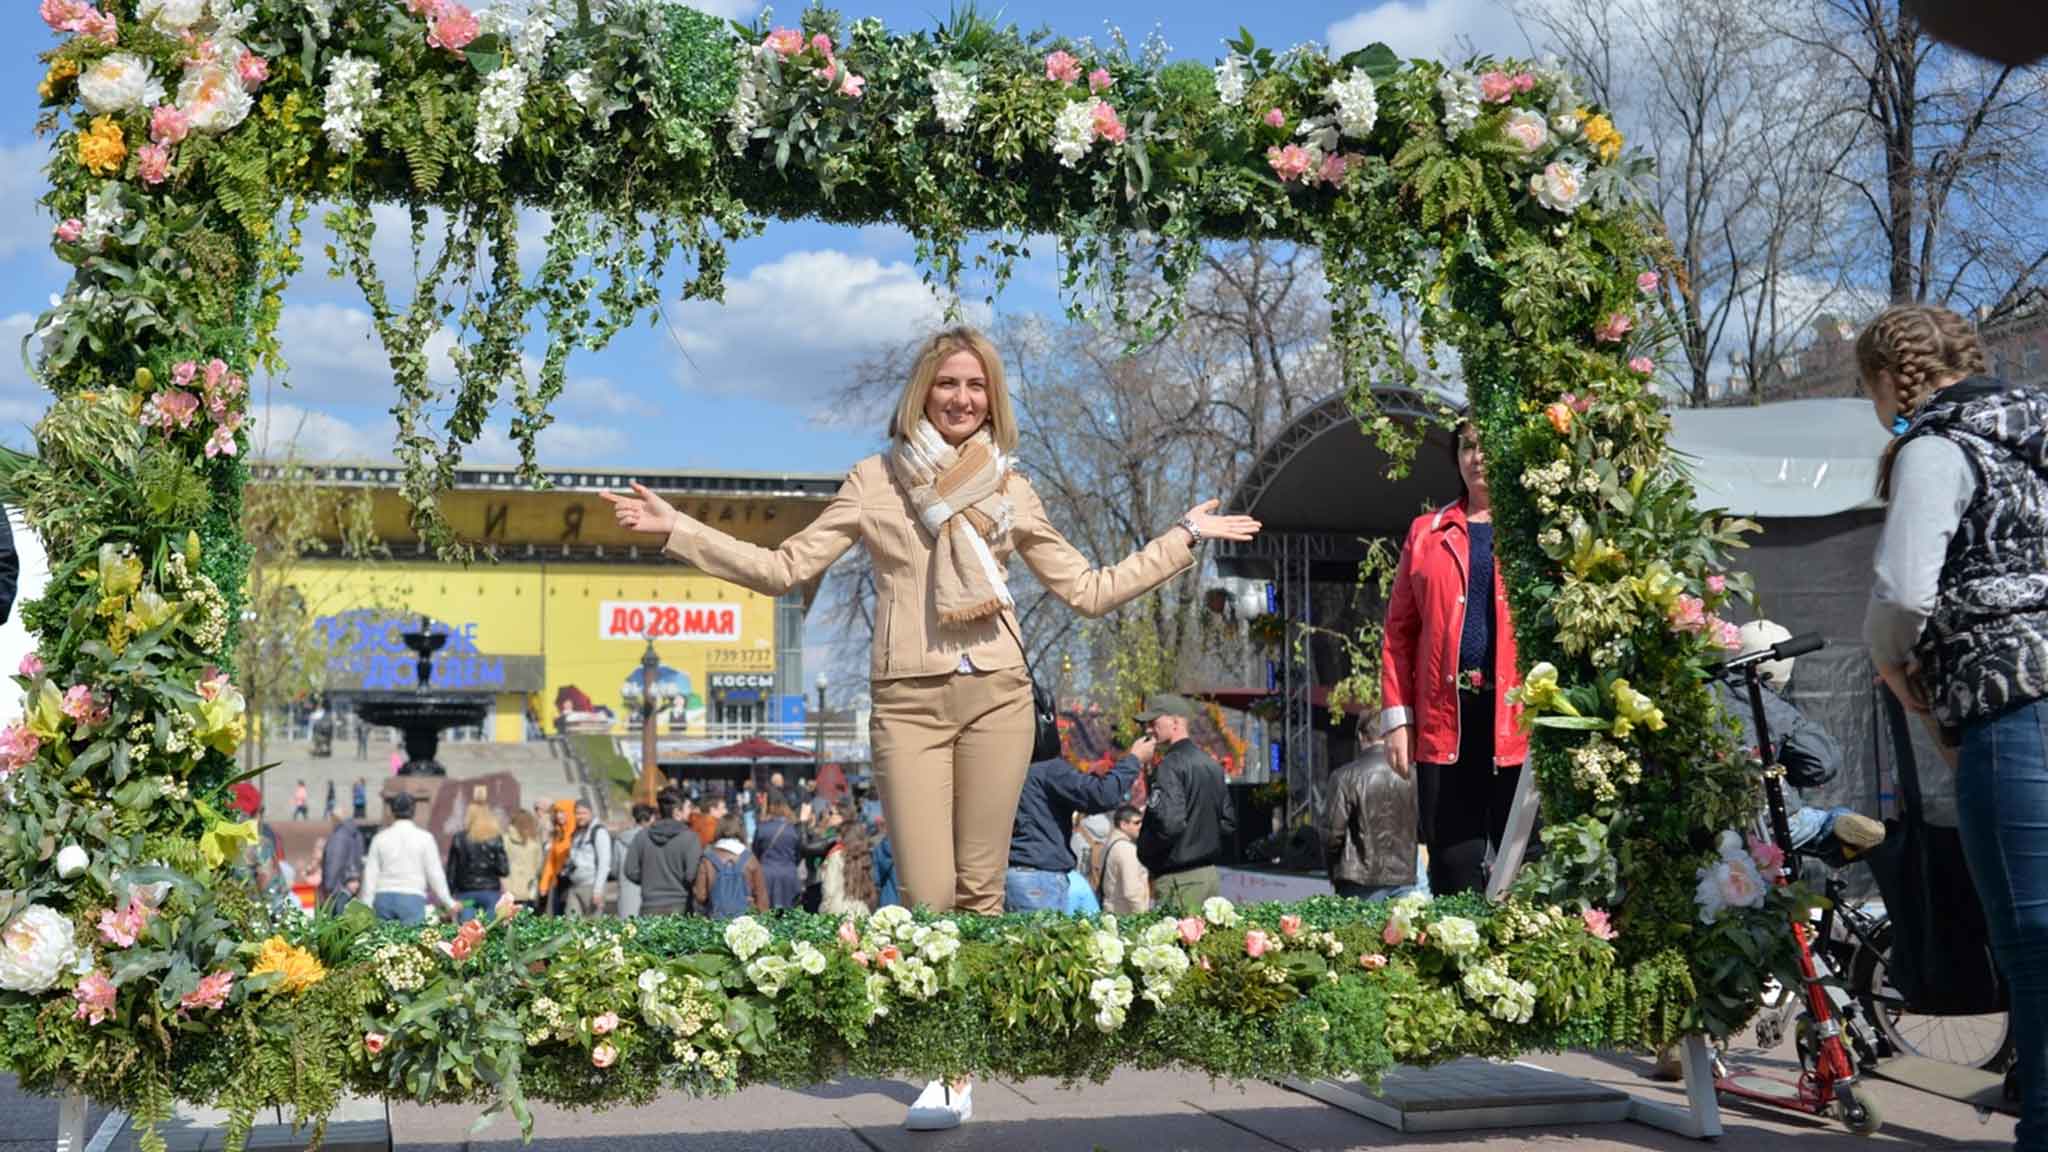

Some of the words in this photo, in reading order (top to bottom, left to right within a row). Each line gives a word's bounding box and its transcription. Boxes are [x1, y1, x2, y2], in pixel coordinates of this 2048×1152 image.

[610, 607, 644, 635] ДО
[647, 606, 680, 636] 28
[684, 609, 735, 634] МАЯ
